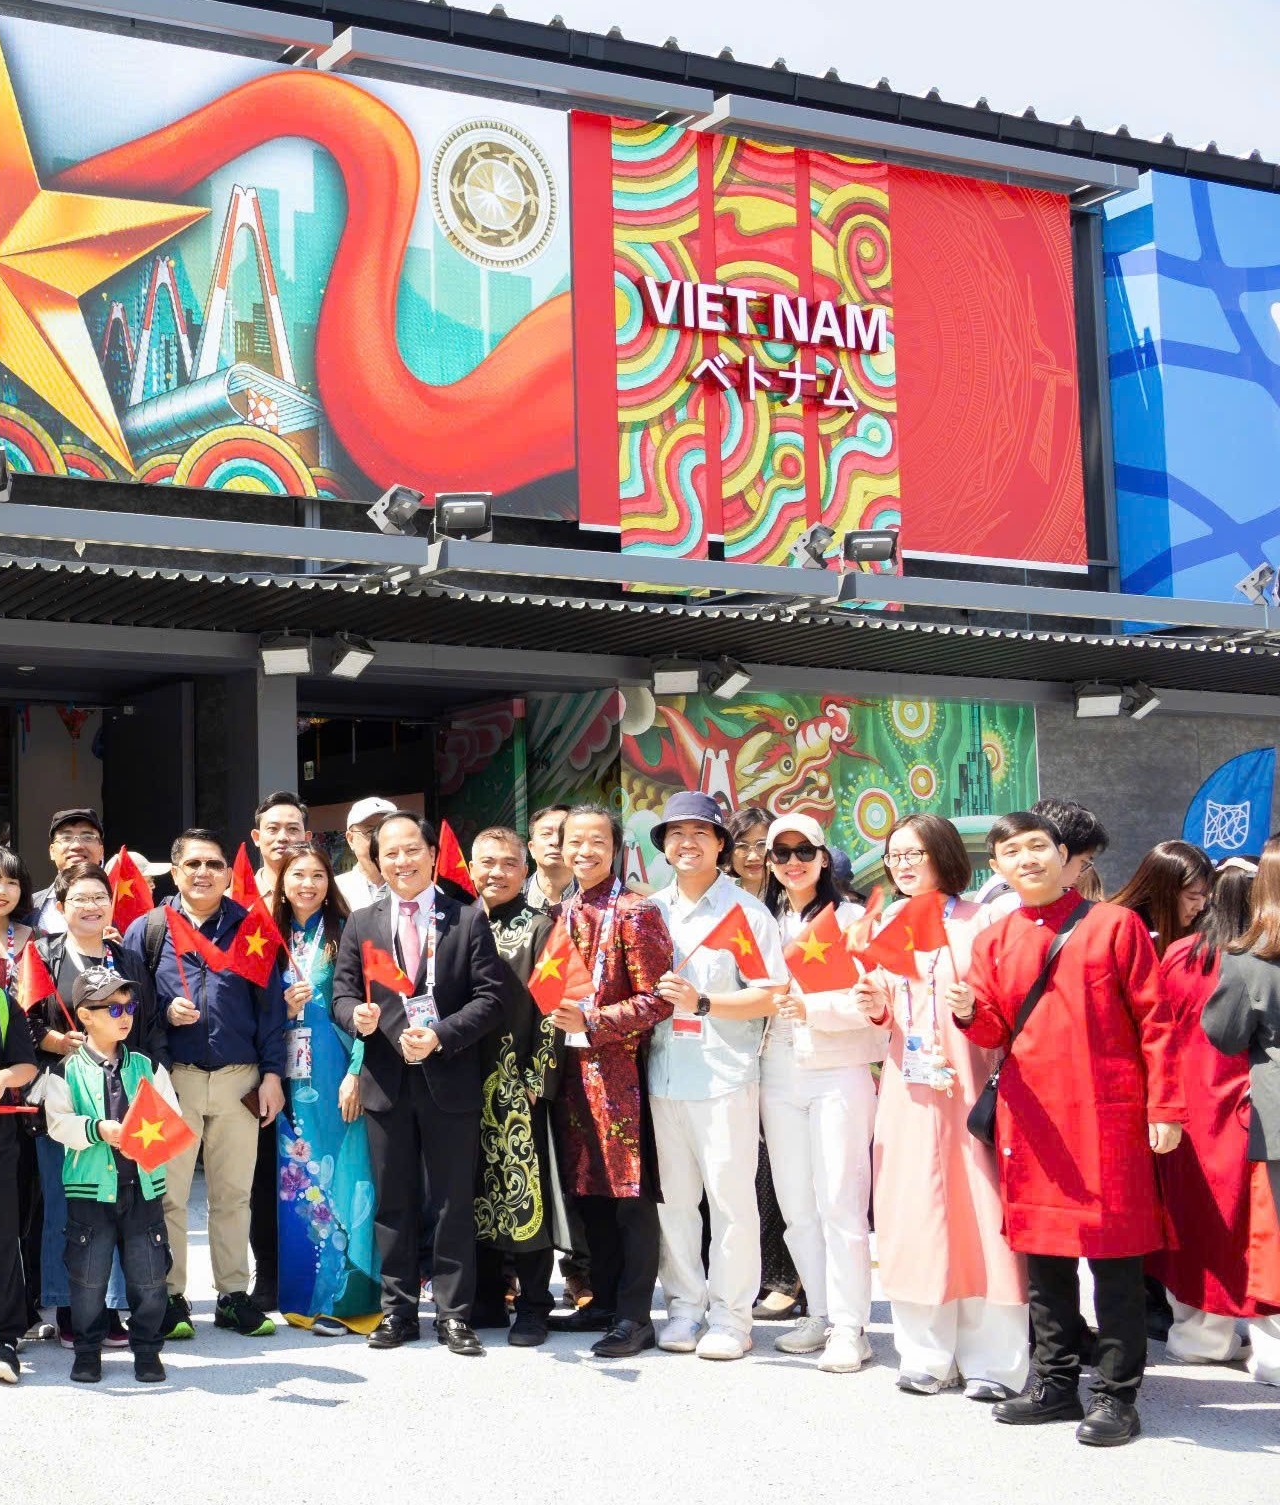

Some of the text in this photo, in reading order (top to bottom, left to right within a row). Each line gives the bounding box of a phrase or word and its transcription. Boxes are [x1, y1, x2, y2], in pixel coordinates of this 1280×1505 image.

[642, 275, 888, 353] VIET NAM
[691, 352, 860, 411] ベトナム
